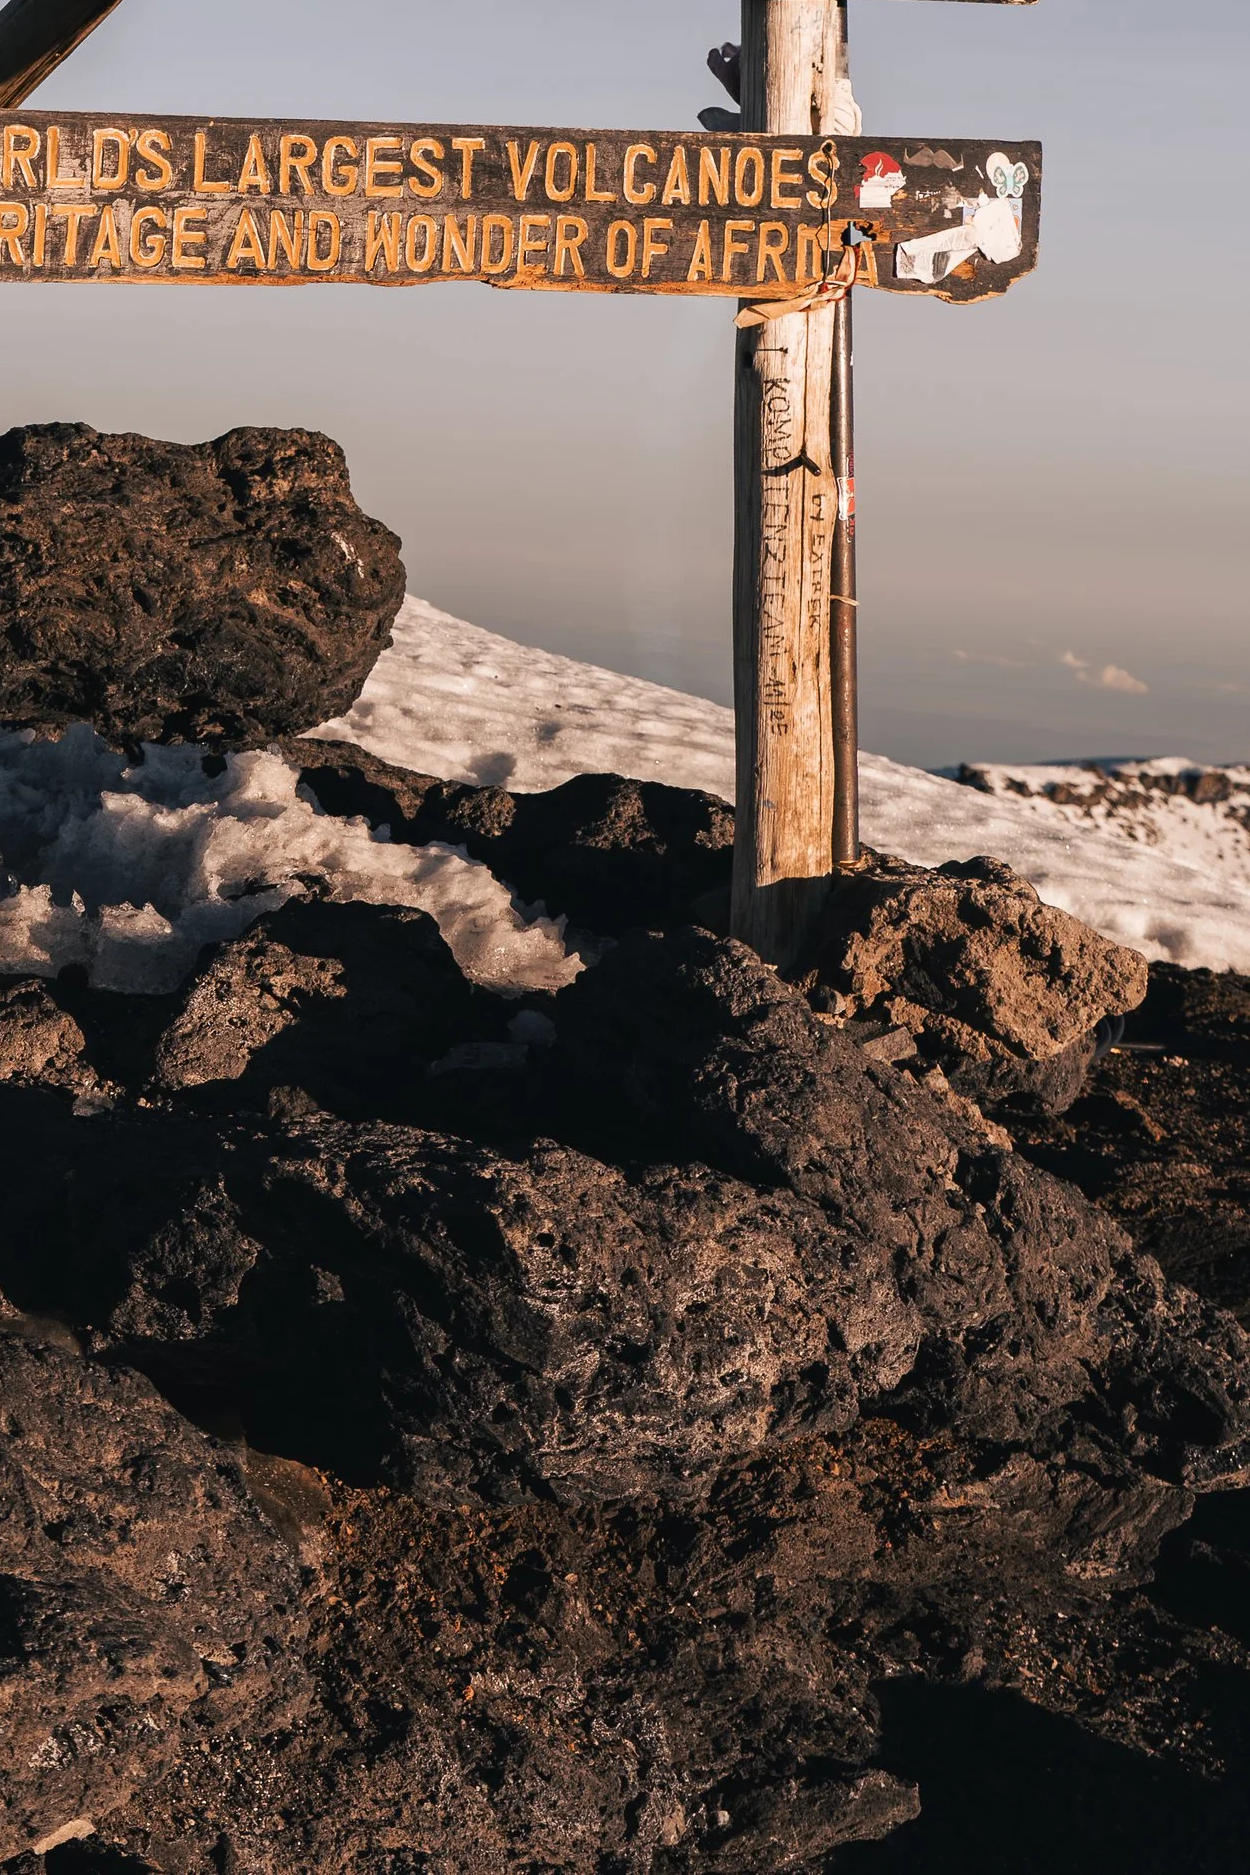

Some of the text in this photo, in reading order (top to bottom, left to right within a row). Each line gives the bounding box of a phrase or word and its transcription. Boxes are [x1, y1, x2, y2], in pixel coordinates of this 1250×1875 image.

[194, 132, 486, 200] LARGEST
[505, 140, 840, 210] VOLCANOES
[227, 208, 341, 271] AND
[365, 211, 590, 278] WONDER
[605, 219, 674, 278] OF
